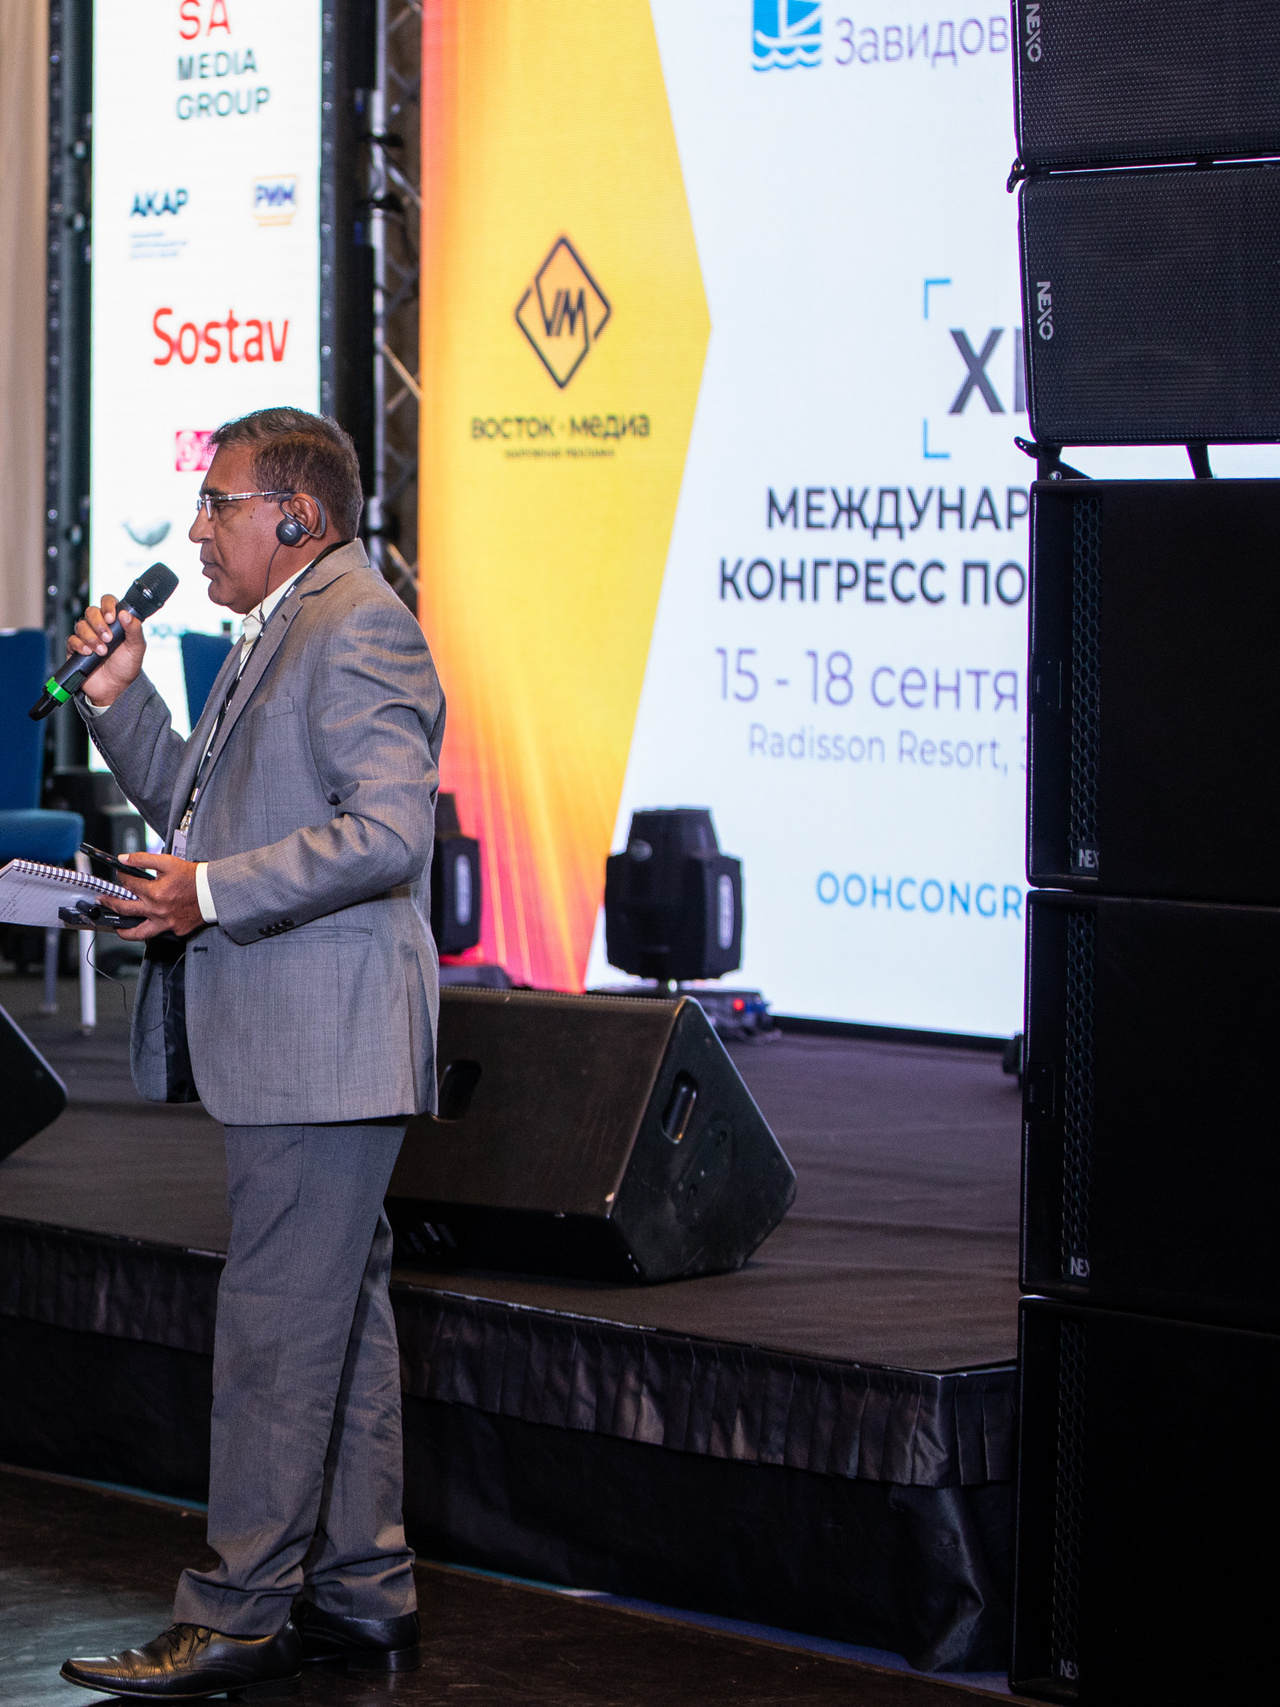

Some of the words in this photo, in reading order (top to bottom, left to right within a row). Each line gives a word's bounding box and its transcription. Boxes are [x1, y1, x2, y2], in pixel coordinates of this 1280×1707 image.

[835, 16, 1009, 67] Завидов
[1025, 3, 1042, 63] NEXO
[177, 49, 258, 81] MEDIA
[176, 87, 271, 120] GROUP
[152, 307, 289, 366] Sostav
[1036, 281, 1054, 341] NEXO
[471, 416, 554, 440] ВОСТОК
[767, 486, 1029, 541] МЕЖДУНАР
[719, 557, 947, 605] КОНГРЕСС
[962, 560, 1027, 606] ПО
[715, 647, 759, 702] 15
[806, 650, 854, 707] 18
[871, 666, 1019, 712] сентя
[748, 722, 886, 763] Radisson
[898, 729, 1008, 776] Resort,
[816, 871, 1023, 920] OOHCONGR
